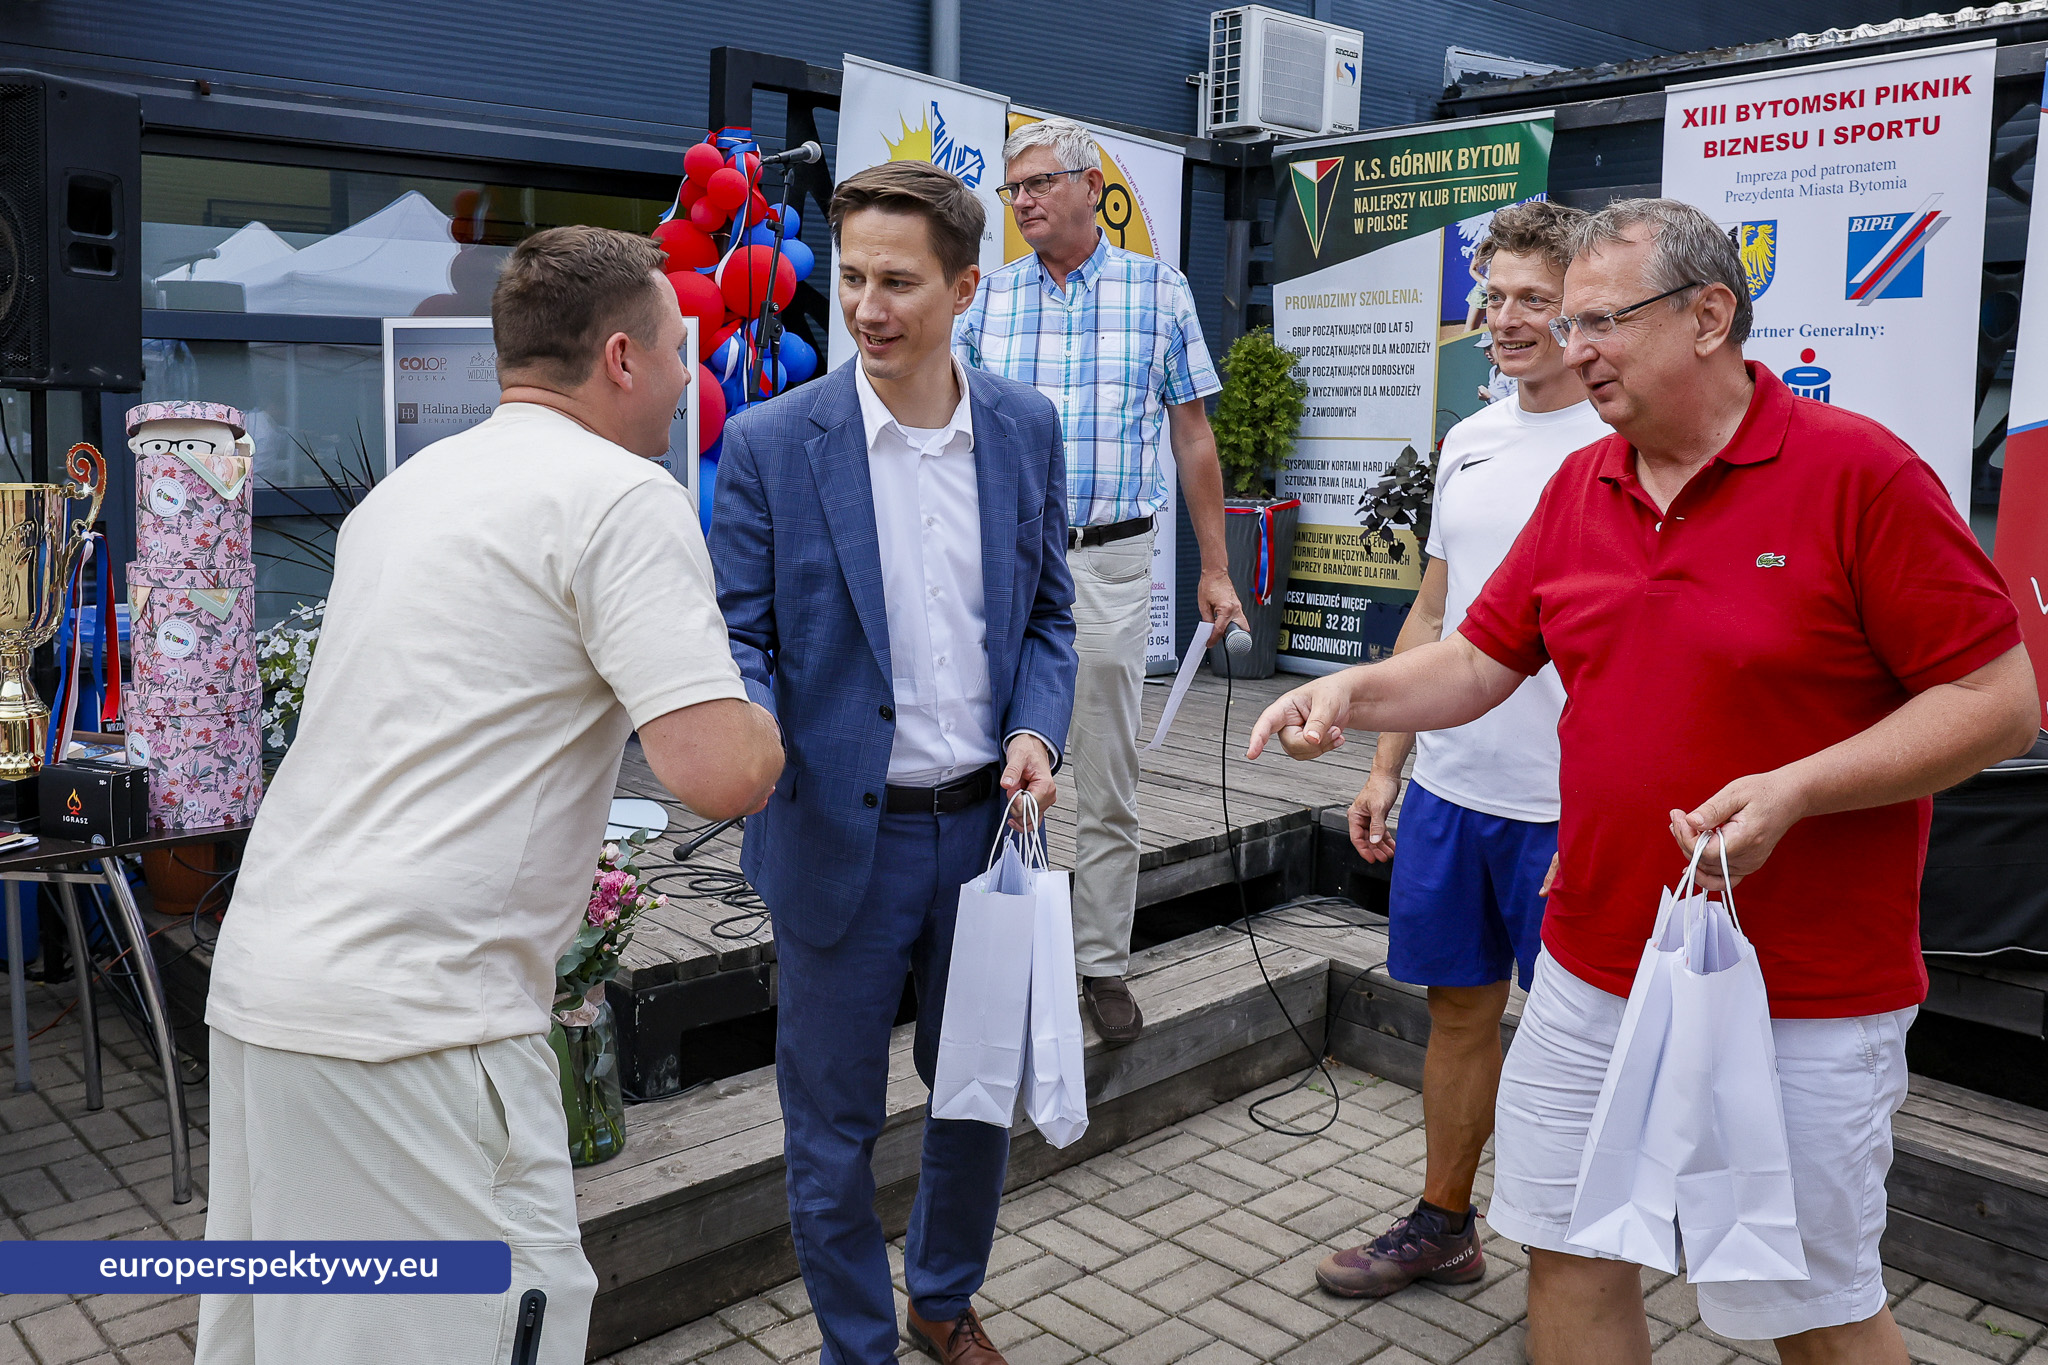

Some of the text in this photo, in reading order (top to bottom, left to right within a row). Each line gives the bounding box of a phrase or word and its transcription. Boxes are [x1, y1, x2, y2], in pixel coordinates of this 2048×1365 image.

[1681, 74, 1973, 129] XIII BYTOMSKI PIKNIK
[1703, 115, 1942, 158] BIZNESU I SPORTU
[1354, 141, 1521, 182] K.S. GÓRNIK BYTOM
[1120, 163, 1139, 194] zaczyna
[1735, 159, 1897, 188] Impreza pod patronatem
[1354, 190, 1416, 214] NAJLEPSZY
[1419, 188, 1450, 208] KLUB
[1453, 182, 1518, 204] TENISOWY
[1725, 177, 1908, 204] Prezydenta Miasta Bytomia
[1354, 213, 1409, 235] W POLSCE
[1849, 215, 1897, 232] BIPH
[1285, 288, 1424, 310] PROWADZIMY SZKOLENIA:
[1292, 320, 1414, 338] GRUP POCZĄTKUJĄCYCH (OD LAT 5)
[1748, 321, 1885, 340] artner Generalny:
[1311, 343, 1371, 358] POCZĄTKUJĄCYCH
[1372, 343, 1387, 355] DLA
[1388, 340, 1431, 354] MŁODZIEŻY
[399, 357, 447, 371] COLOP
[1292, 364, 1415, 378] GRUP POCZĄTKUJĄCYCH DOROSŁYCH
[467, 369, 498, 381] WIDZIMI
[1312, 385, 1362, 397] WYCZYNOWYCH
[1363, 386, 1378, 397] DLA
[1379, 383, 1422, 397] MŁODZIEŻY
[423, 403, 492, 415] Halina Bieda
[1312, 406, 1357, 418] ZAWODOWYCH
[1331, 460, 1360, 472] KORTAMI
[1362, 461, 1383, 472] HARD
[1284, 475, 1316, 487] SZTUCZNA
[1318, 476, 1340, 488] TRAWA
[1302, 492, 1323, 503] KORTY
[1324, 493, 1355, 505] OTWARTE
[1294, 545, 1331, 559] TURNIEJÓW
[1292, 560, 1400, 580] IMPREZY BRANŻOWE DLA FIRM.
[1286, 591, 1304, 604] CESZ
[1306, 593, 1341, 608] WIEDZIEĆ
[1325, 613, 1339, 630] 32
[1340, 615, 1361, 633] 281
[1156, 635, 1169, 645] 054
[62, 815, 89, 825] IGRASZ
[1432, 1246, 1474, 1271] LACOSTE
